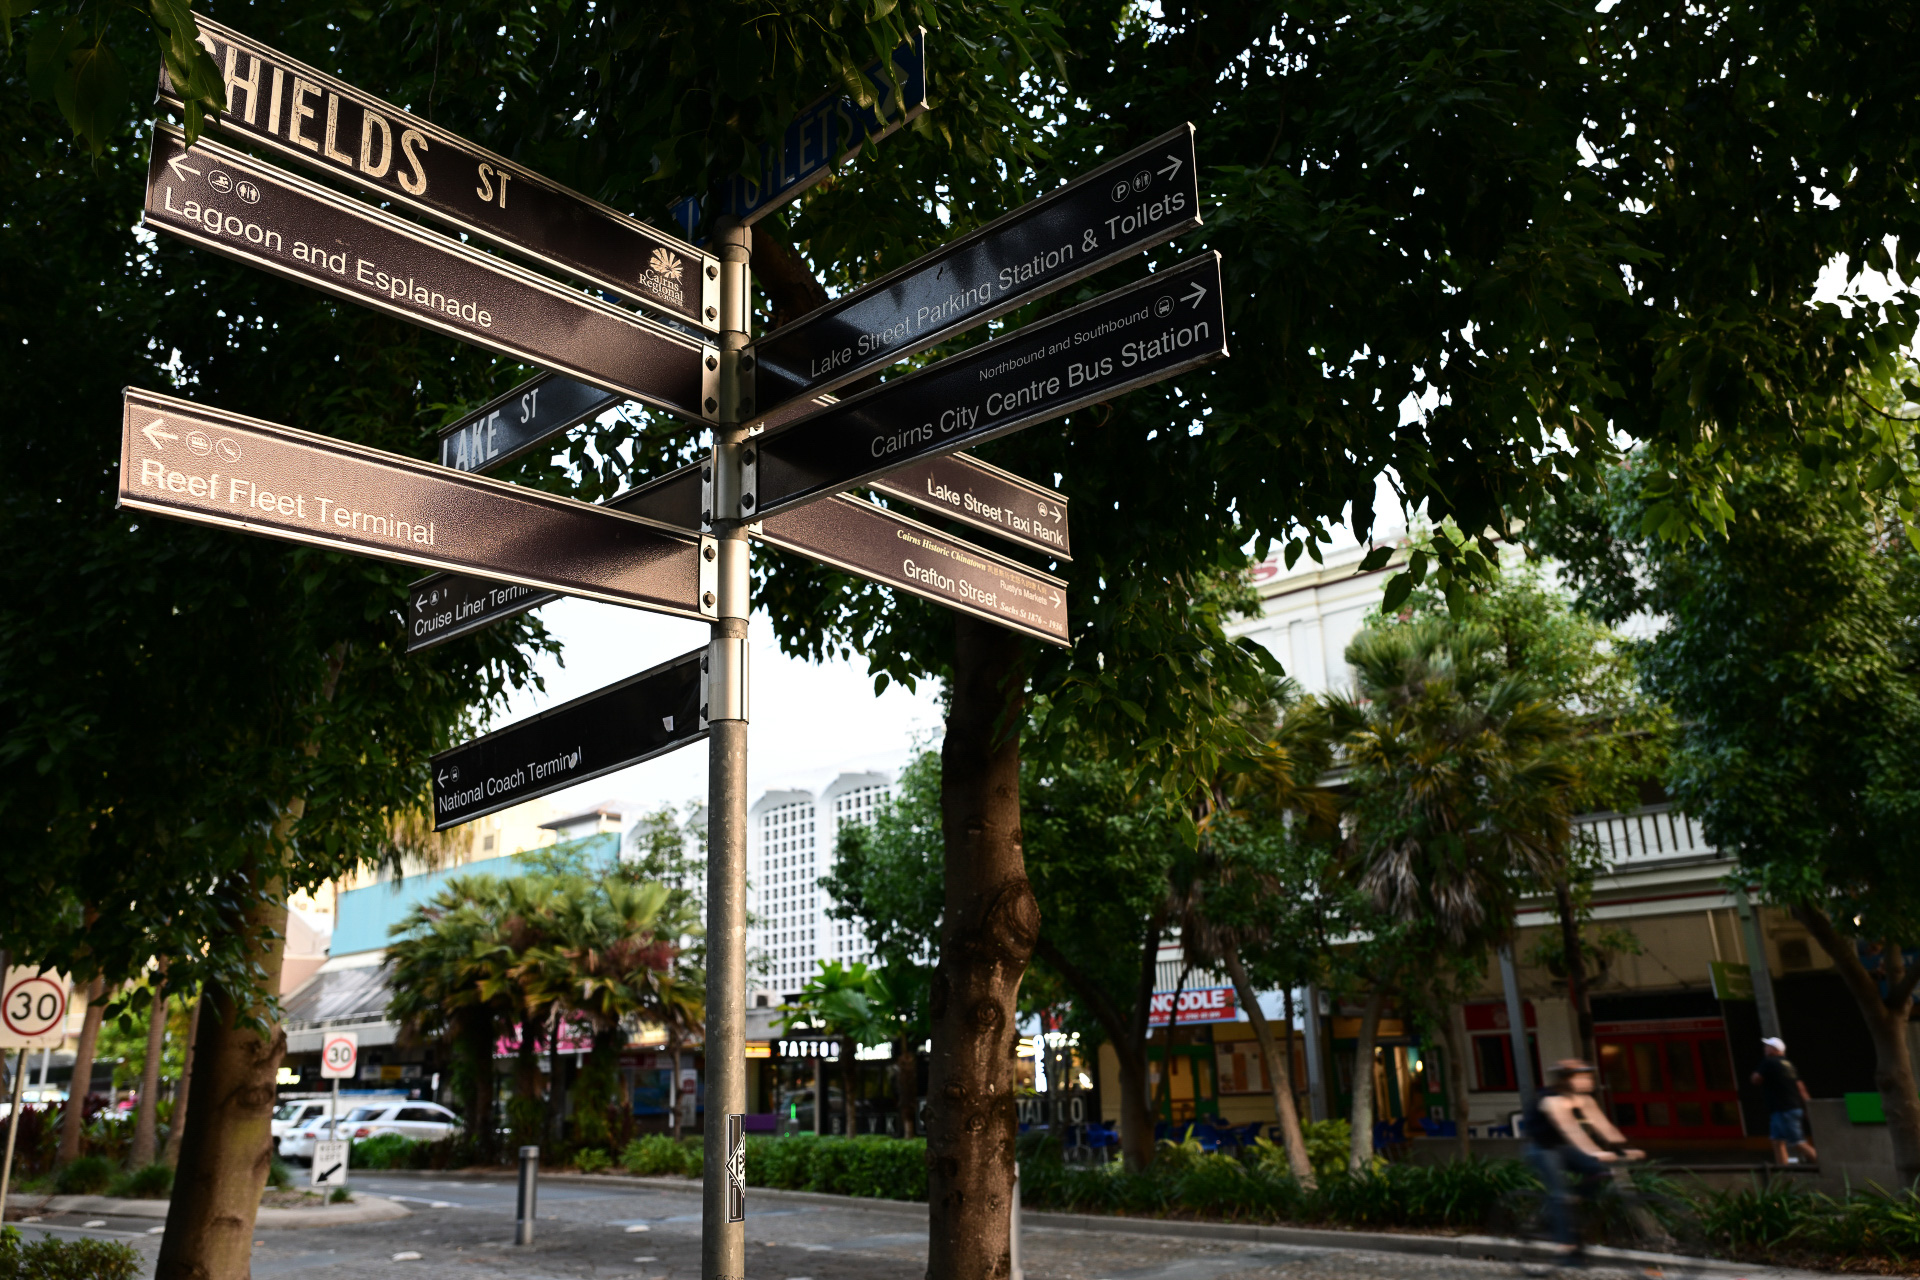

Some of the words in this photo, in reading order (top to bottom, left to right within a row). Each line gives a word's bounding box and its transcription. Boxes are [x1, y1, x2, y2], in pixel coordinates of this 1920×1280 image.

[195, 32, 429, 196] HIELDS
[476, 162, 511, 209] ST
[164, 186, 283, 252] Lagoon
[292, 240, 347, 276] and
[356, 258, 493, 329] Esplanade
[645, 268, 679, 292] Cairns
[639, 273, 684, 302] Regional
[810, 345, 852, 379] Lake
[857, 315, 910, 356] Street
[916, 280, 991, 326] Parking
[998, 243, 1073, 291] Station
[1081, 228, 1099, 253] &
[1104, 191, 1186, 242] Toilets
[978, 346, 1046, 382] Northbound
[1048, 336, 1071, 355] and
[1073, 306, 1149, 346] Southbound
[520, 387, 539, 424] ST
[871, 422, 933, 458] Cairns
[939, 405, 980, 433] City
[986, 375, 1061, 417] Centre
[1067, 353, 1114, 388] Bus
[1121, 320, 1210, 368] Station
[140, 458, 220, 500] Reef
[229, 477, 306, 519] Fleet
[314, 496, 435, 546] Terminal
[927, 478, 961, 506] Lake
[963, 493, 1003, 523] Street
[1004, 509, 1031, 534] Taxi
[1033, 520, 1064, 547] Rank
[896, 529, 921, 546] Cairns
[922, 538, 950, 557] Historic
[950, 550, 987, 572] Chinatown
[903, 559, 955, 593] Grafton
[958, 578, 998, 609] Street
[999, 579, 1023, 598] Rusty's
[1023, 588, 1048, 606] Markets
[414, 611, 452, 637] Cruise
[455, 597, 486, 621] Liner
[488, 585, 533, 607] Term
[999, 602, 1019, 616] Sachs
[1019, 608, 1027, 619] St
[438, 781, 484, 814] National
[486, 768, 525, 797] Coach
[527, 745, 582, 782] Terminl
[11, 992, 57, 1020] 30
[1149, 989, 1226, 1014] NOODLE
[328, 1046, 351, 1063] 30
[778, 1040, 840, 1058] TATTOO
